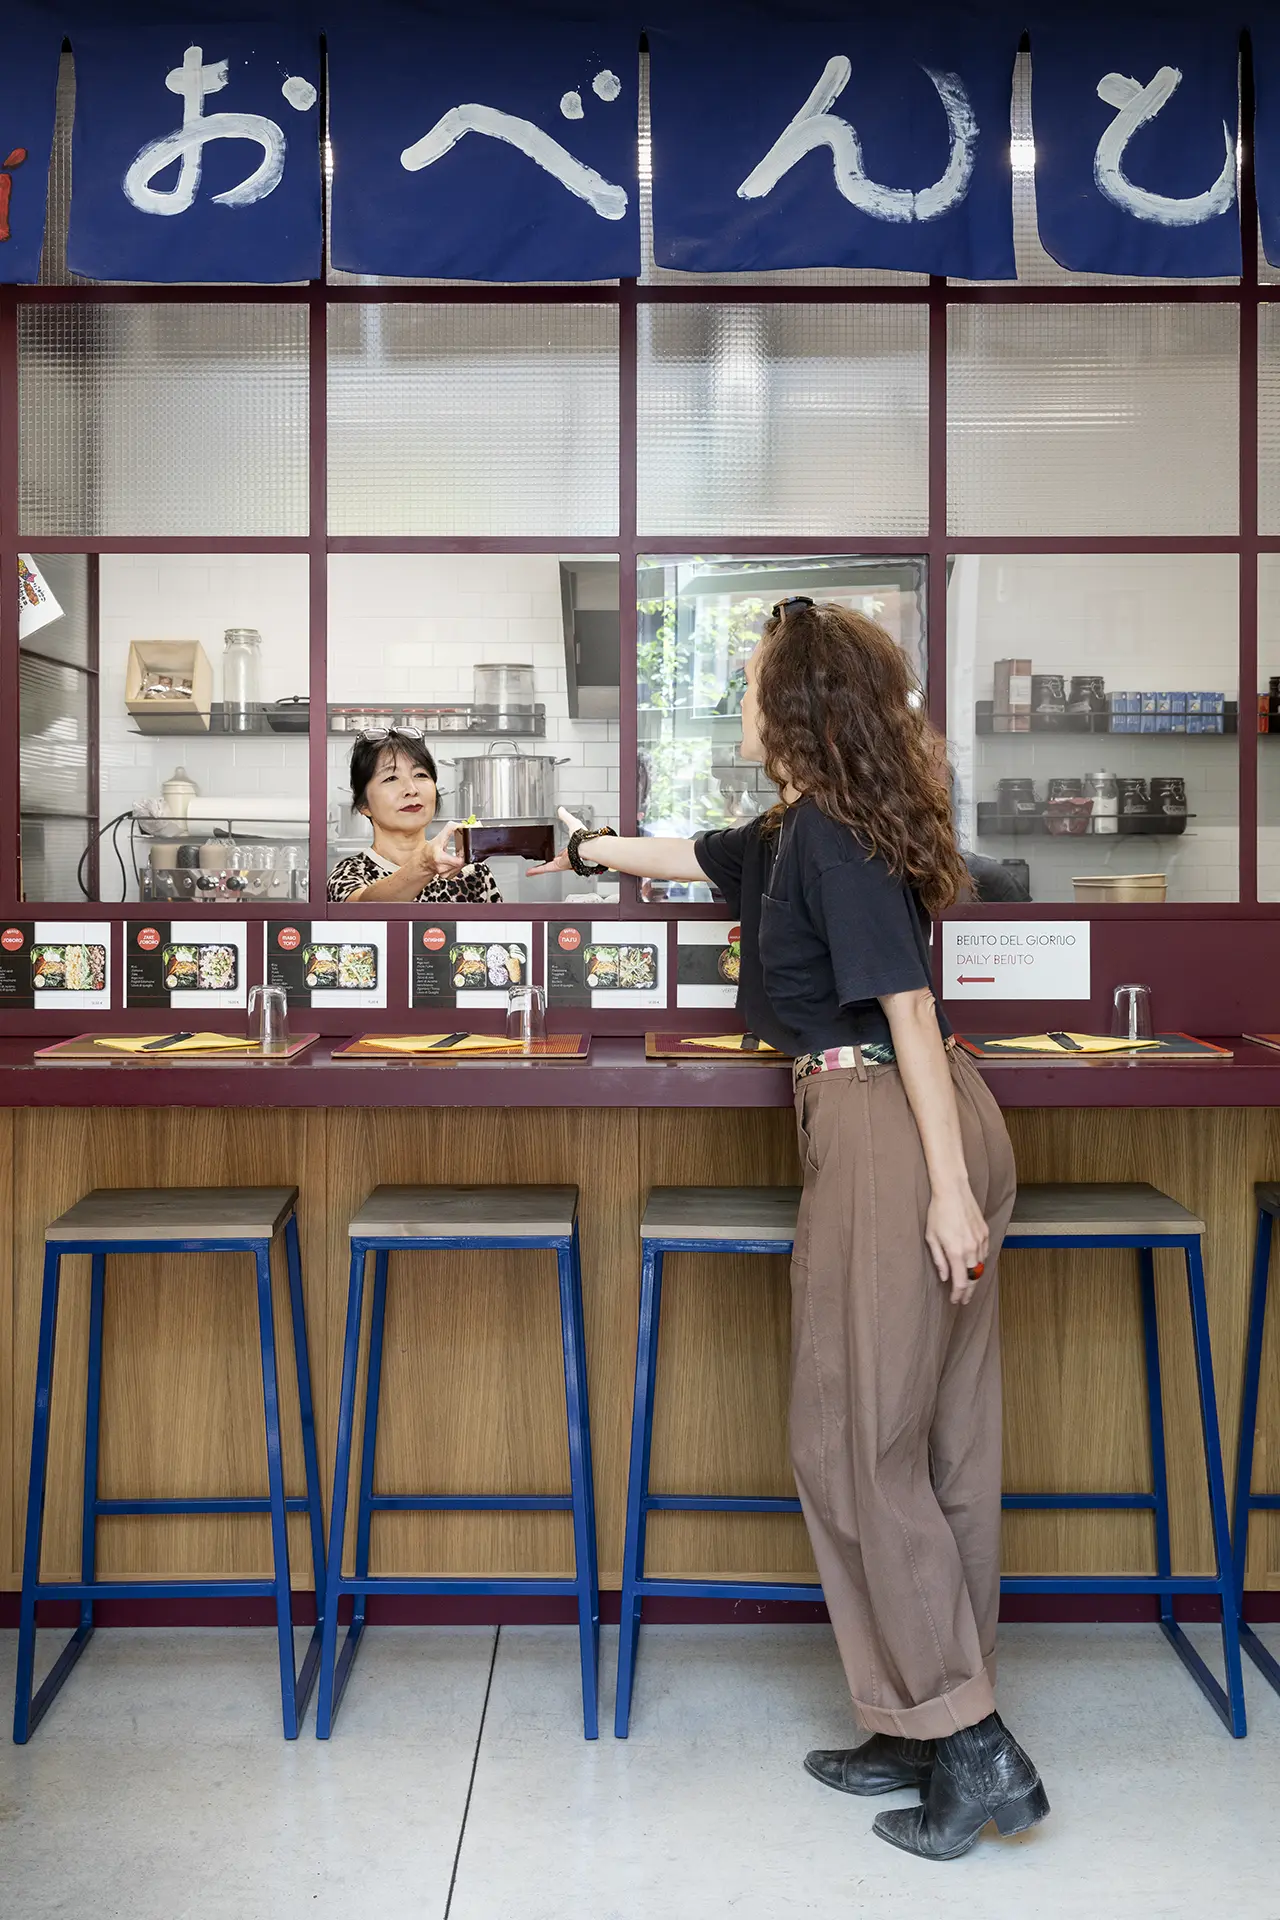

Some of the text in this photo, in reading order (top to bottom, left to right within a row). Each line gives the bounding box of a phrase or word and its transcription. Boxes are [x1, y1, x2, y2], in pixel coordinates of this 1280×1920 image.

[956, 934, 1076, 946] BENTO DEL GIORNO
[956, 954, 1035, 965] DAILY BENTO
